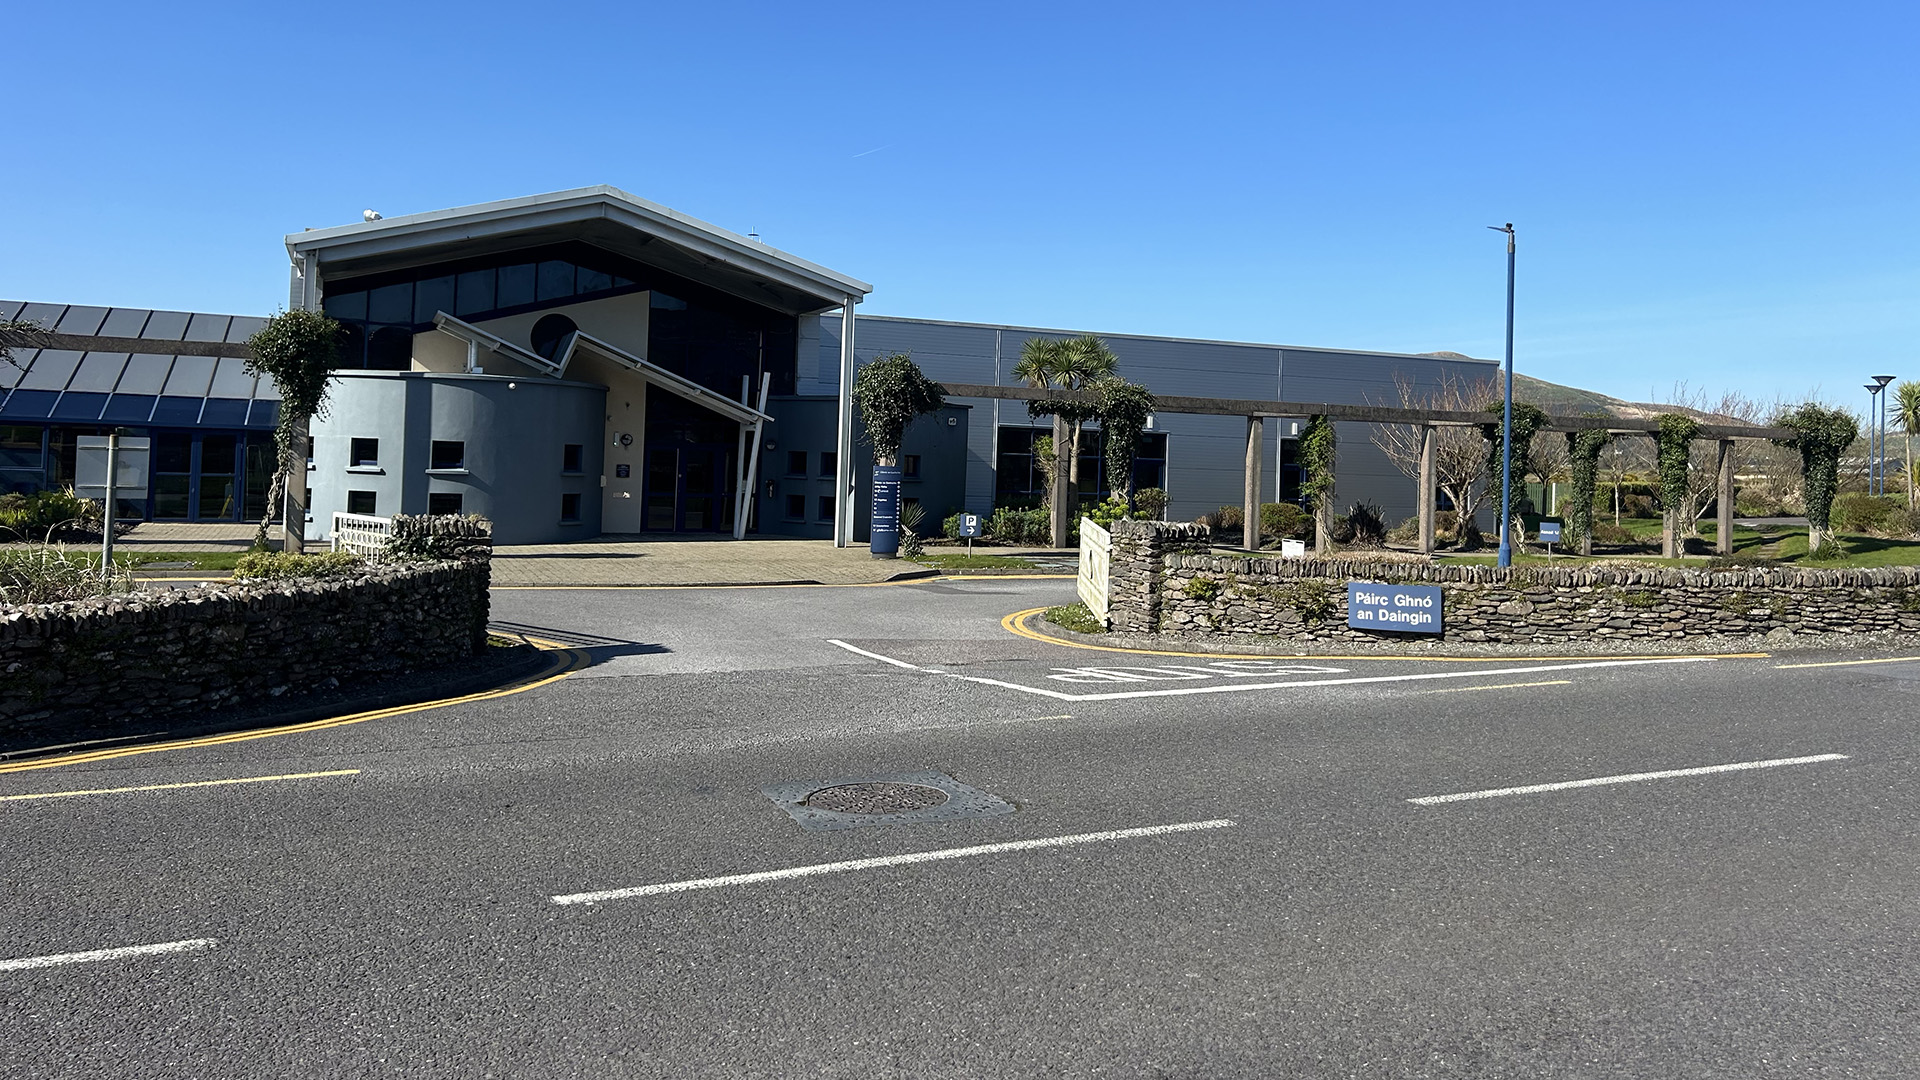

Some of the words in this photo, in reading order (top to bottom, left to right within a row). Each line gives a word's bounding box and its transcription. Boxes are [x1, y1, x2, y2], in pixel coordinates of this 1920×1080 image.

[968, 516, 975, 525] P
[1355, 591, 1389, 606] Páirc
[1394, 594, 1433, 608] Ghnó
[1356, 609, 1374, 620] an
[1378, 608, 1432, 625] Daingin
[1045, 660, 1350, 683] STOP
